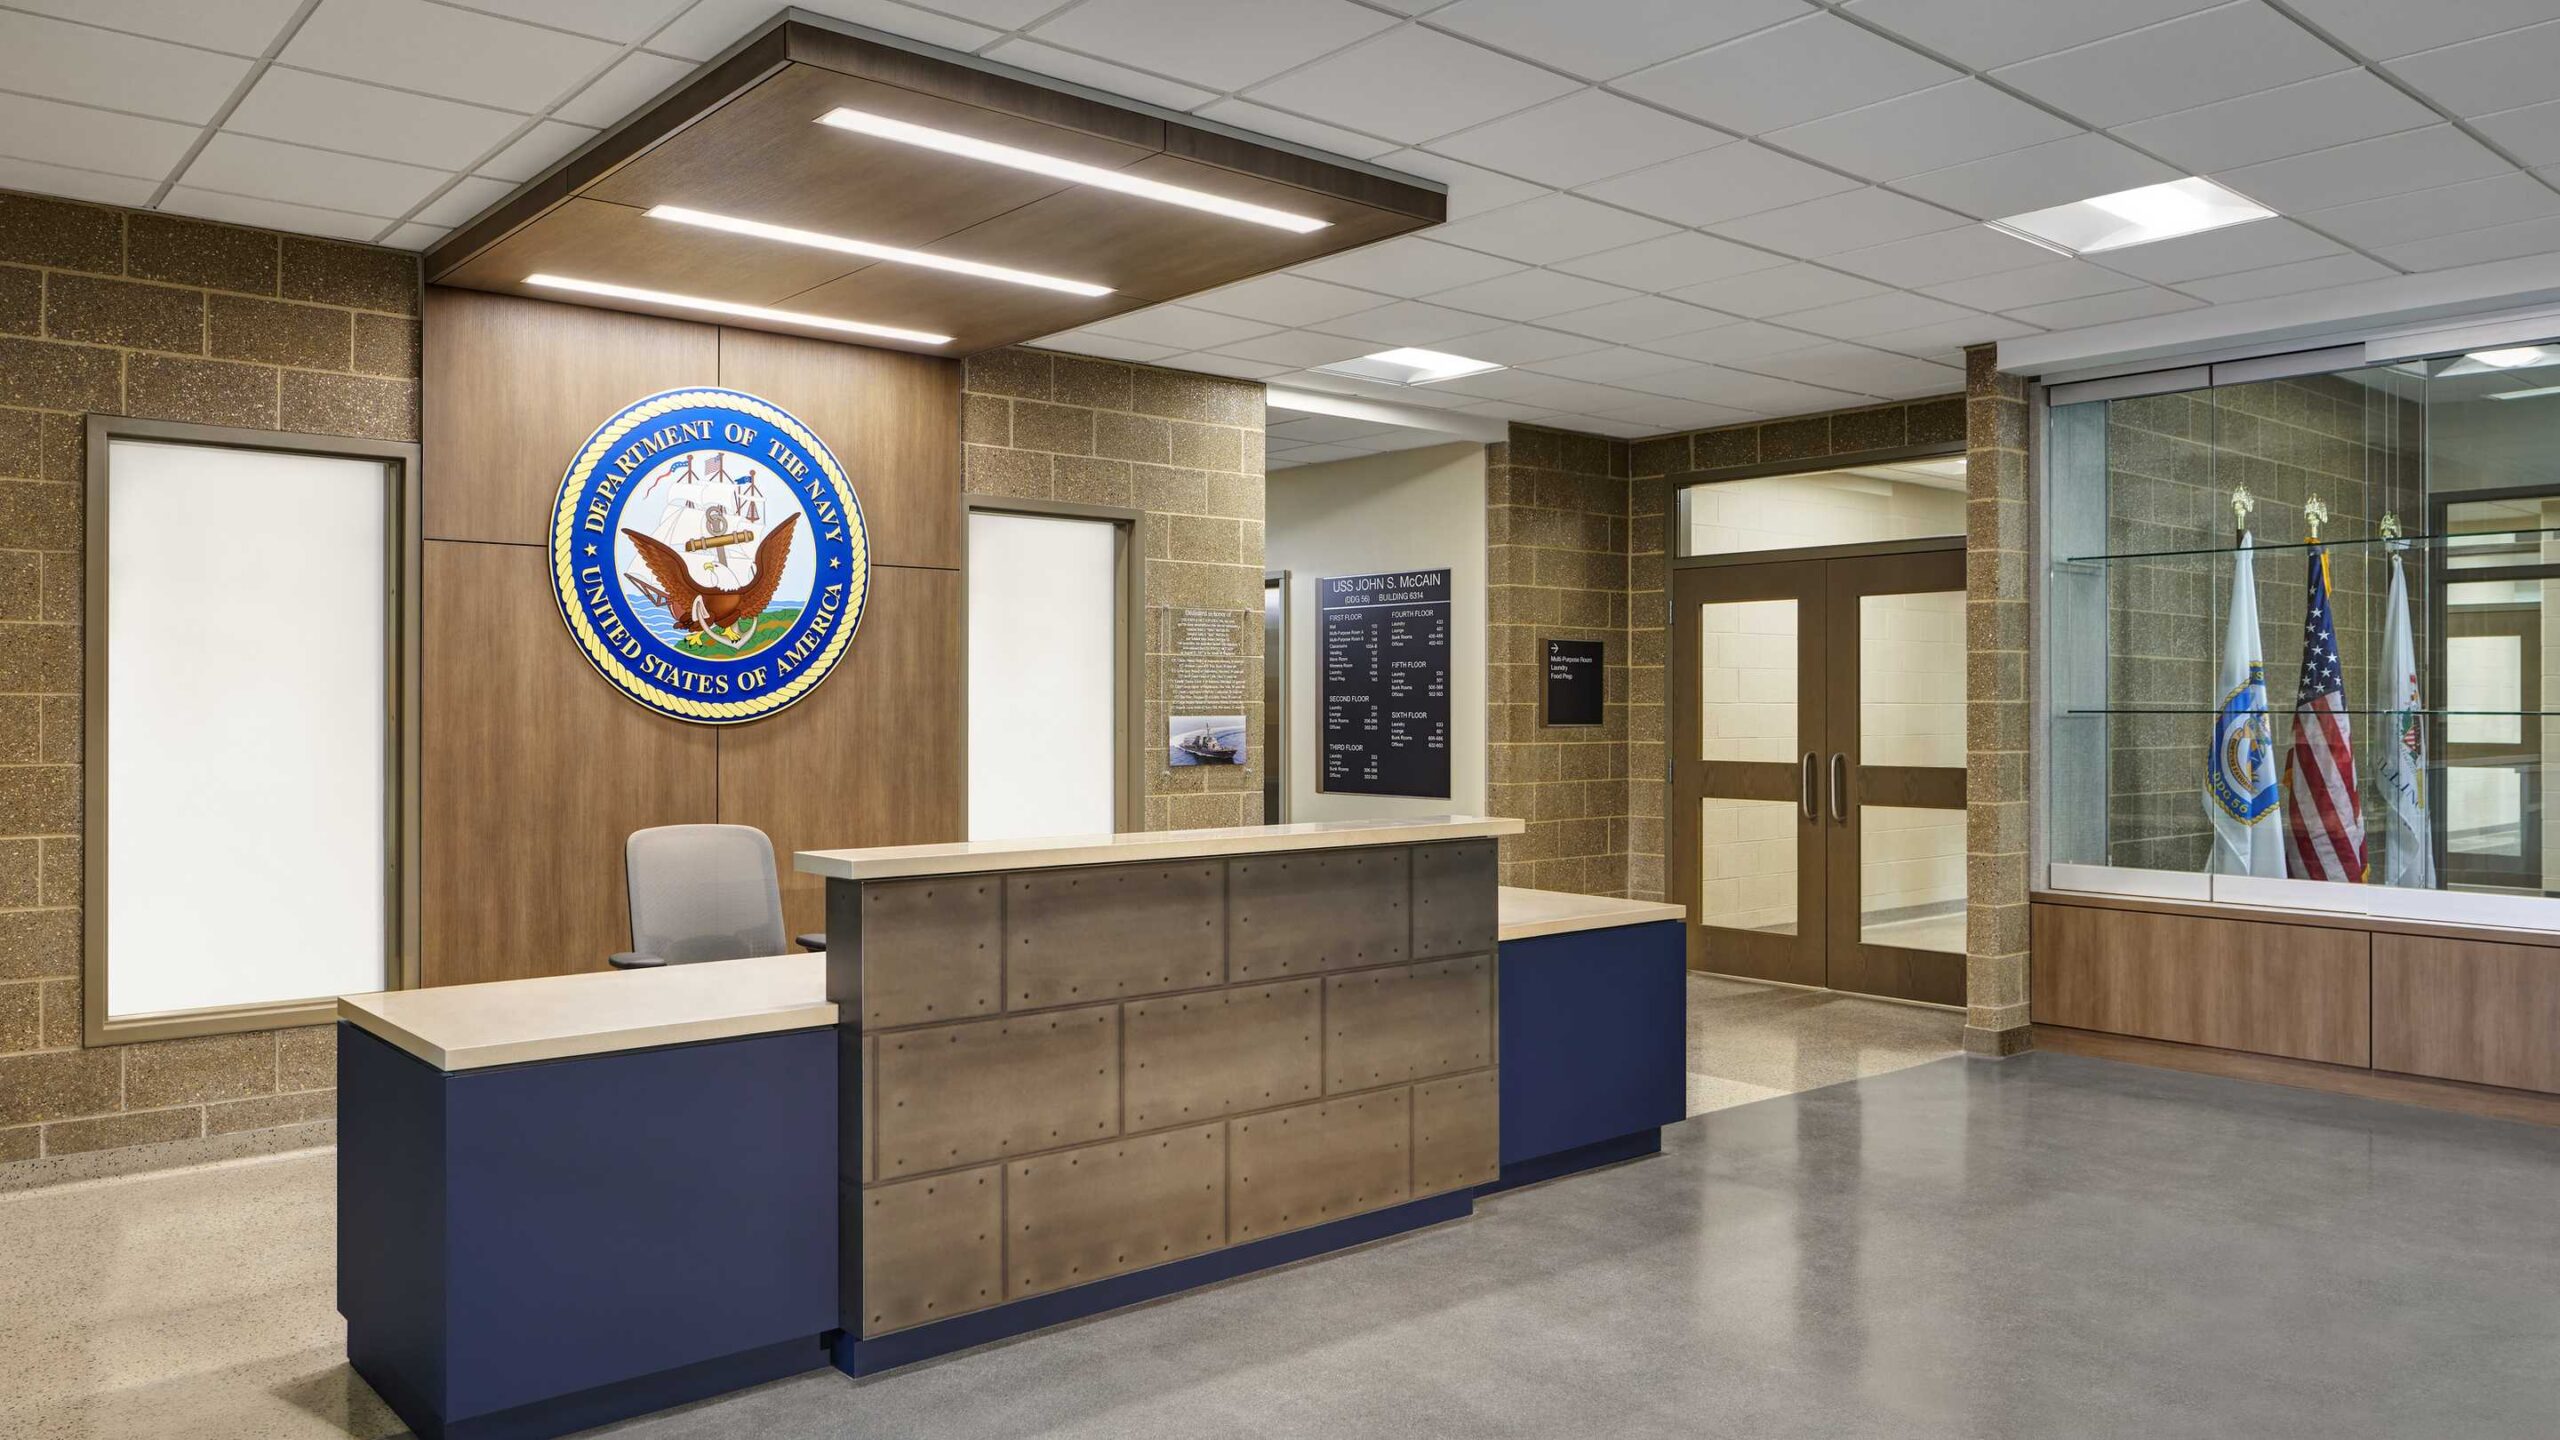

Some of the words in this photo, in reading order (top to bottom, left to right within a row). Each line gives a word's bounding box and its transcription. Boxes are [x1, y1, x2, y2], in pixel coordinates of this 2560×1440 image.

[585, 420, 713, 534] DEPARTMENT
[724, 423, 757, 447] OF
[768, 438, 809, 482] THE
[804, 478, 842, 542] NAVY
[1333, 580, 1353, 592] USS
[1355, 578, 1384, 591] JOHN
[1387, 577, 1396, 589] S.
[1400, 574, 1440, 588] McCAIN
[1345, 596, 1360, 604] (DDG
[1361, 595, 1370, 603] 56)
[1379, 593, 1408, 601] BUILDING
[1409, 592, 1423, 600] 6314
[582, 564, 642, 658] UNITED
[640, 654, 729, 694] STATES
[737, 666, 767, 691] OF
[777, 583, 843, 677] AMERICA
[2231, 799, 2248, 813] 56
